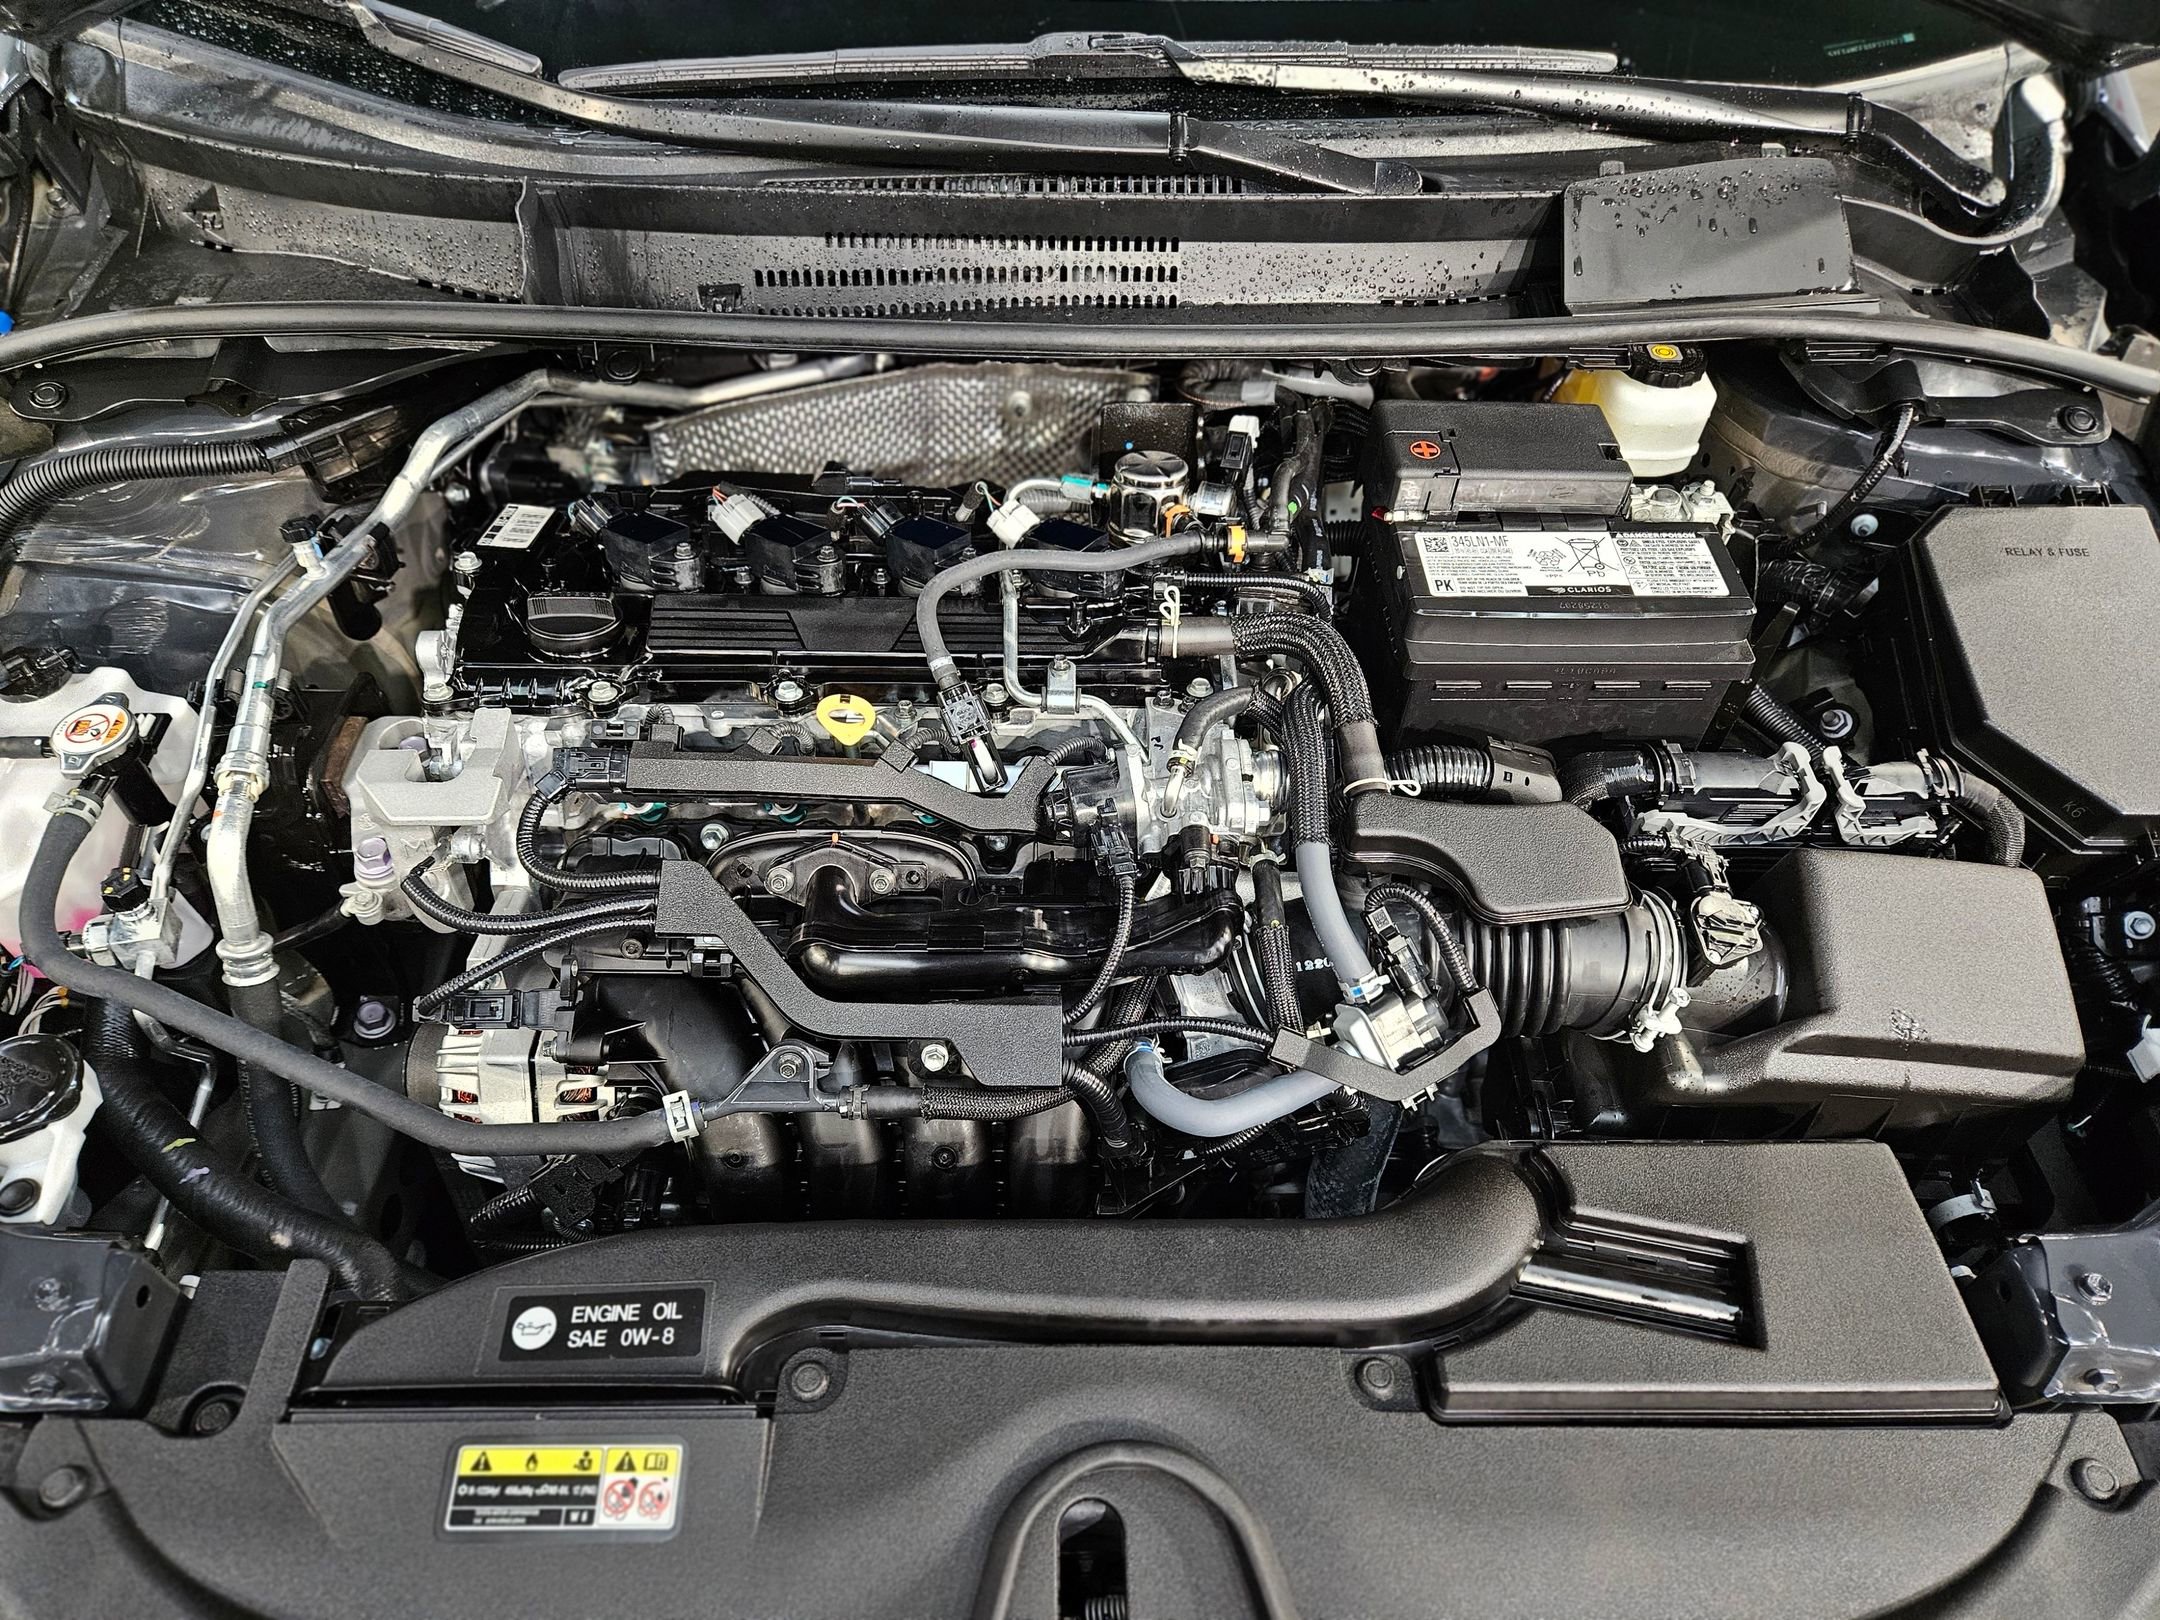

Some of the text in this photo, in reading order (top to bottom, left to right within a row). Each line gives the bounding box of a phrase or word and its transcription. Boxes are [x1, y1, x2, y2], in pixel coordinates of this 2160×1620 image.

[1450, 535, 1510, 547] 345LN1-MF
[2004, 547, 2091, 557] RELAY & FUSE
[1434, 579, 1455, 591] PK
[570, 1301, 684, 1324] ENGINE OIL
[566, 1326, 676, 1349] SAE 0W-8
